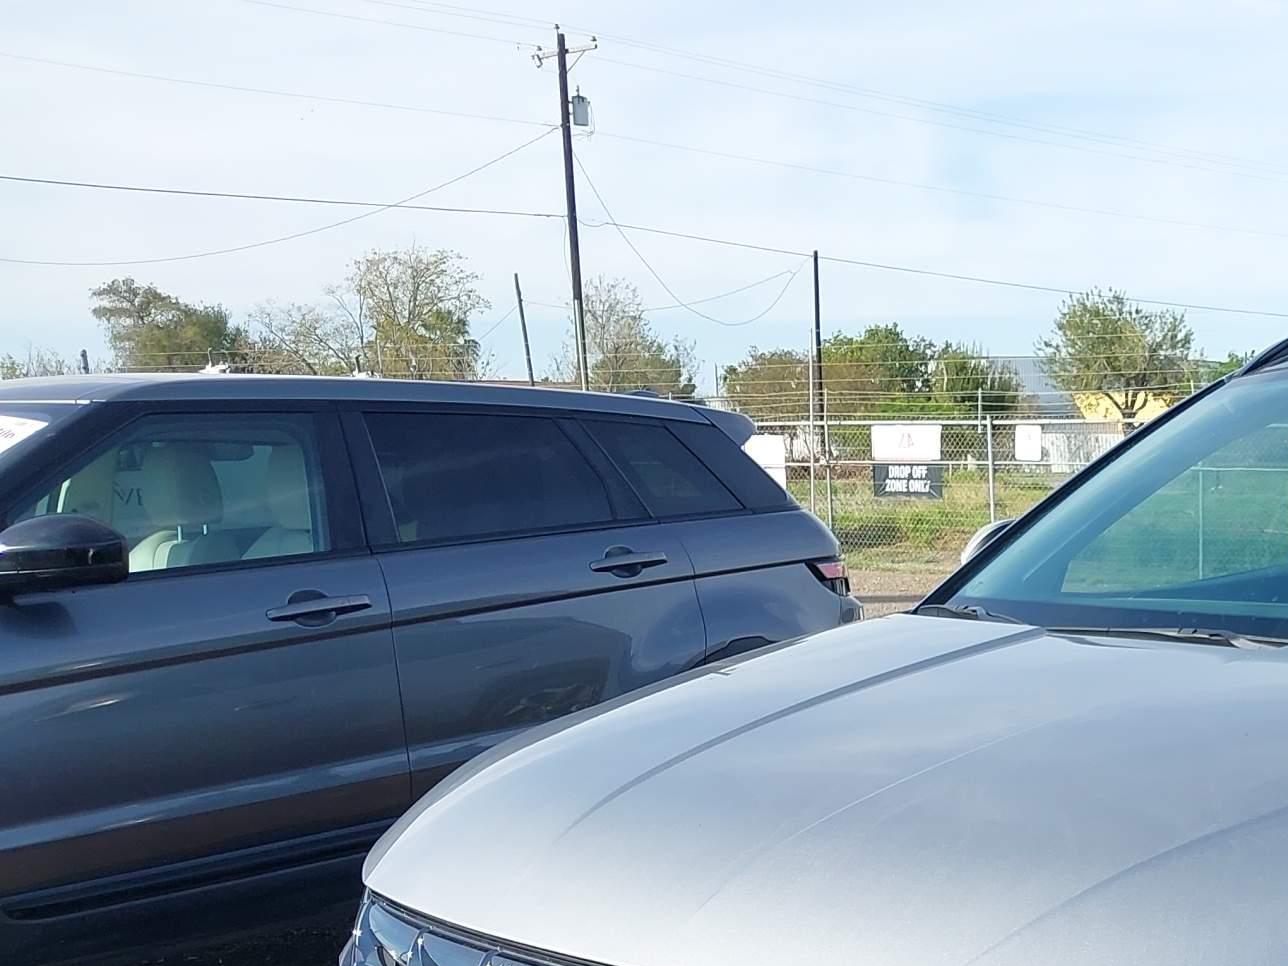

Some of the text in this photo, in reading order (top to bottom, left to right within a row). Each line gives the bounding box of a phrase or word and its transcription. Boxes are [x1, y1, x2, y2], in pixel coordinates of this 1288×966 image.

[888, 465, 928, 479] DROP OFF
[885, 479, 931, 492] ZONE ONLY
